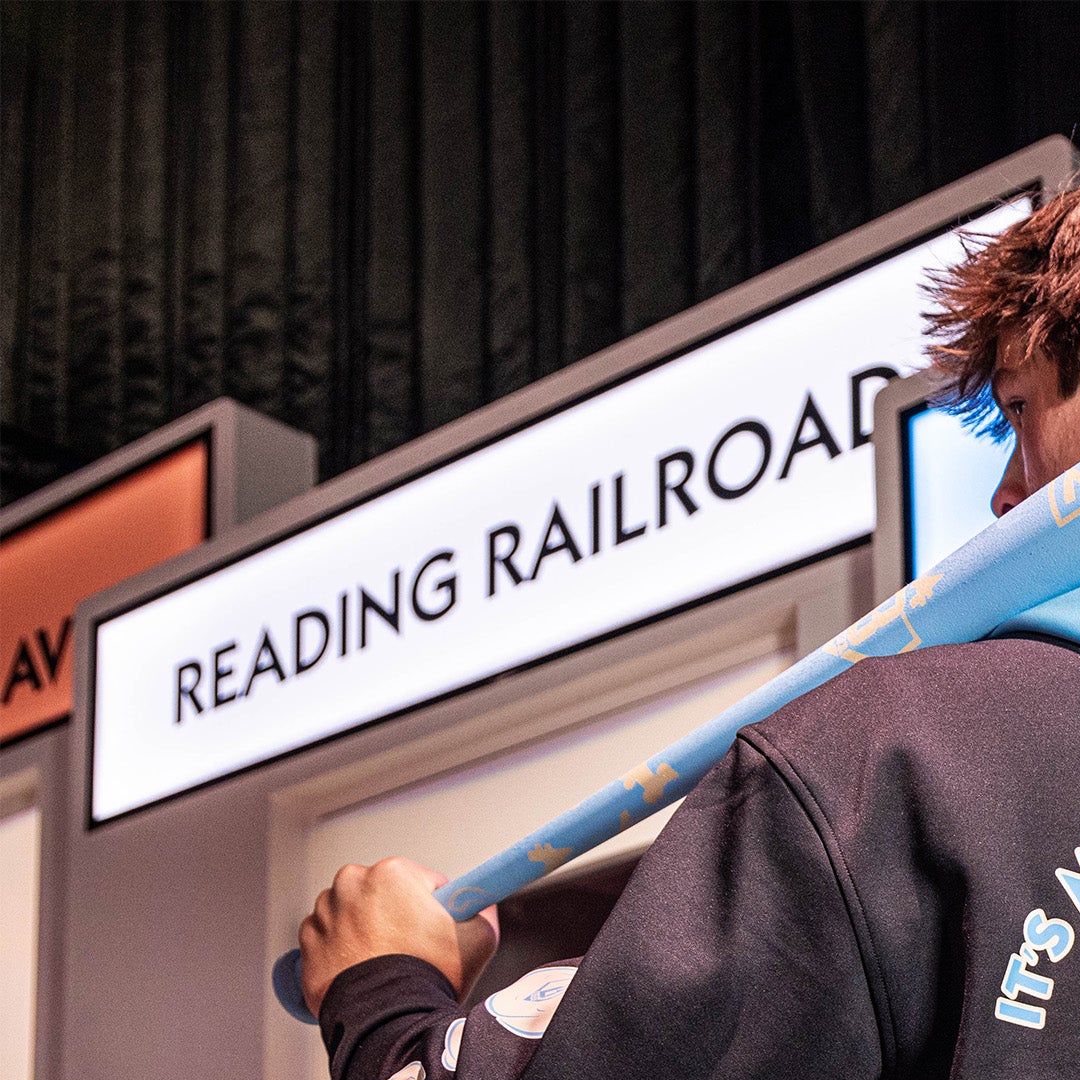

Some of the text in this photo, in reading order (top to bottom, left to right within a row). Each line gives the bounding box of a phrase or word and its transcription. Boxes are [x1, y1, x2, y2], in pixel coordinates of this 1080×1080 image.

[176, 366, 899, 723] READING RAILROAD
[995, 908, 1075, 1029] IT'S
